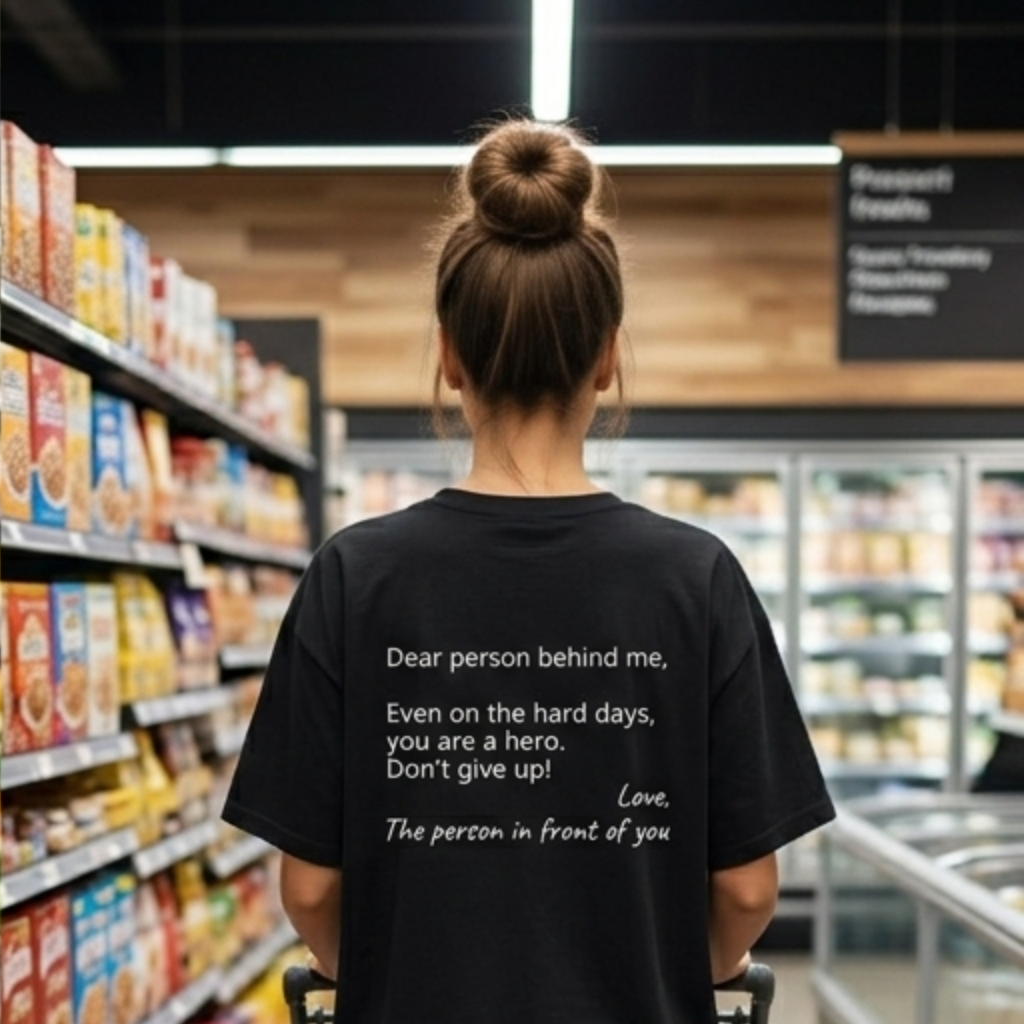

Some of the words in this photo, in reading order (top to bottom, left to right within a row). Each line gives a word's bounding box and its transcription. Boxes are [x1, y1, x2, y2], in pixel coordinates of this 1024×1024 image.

[387, 647, 443, 668] Dear
[449, 651, 531, 673] person
[538, 646, 618, 668] behind
[626, 651, 668, 670] me,
[387, 703, 442, 724] Even
[449, 708, 479, 724] on
[487, 703, 525, 724] the
[533, 702, 587, 724] hard
[595, 702, 655, 729] days,
[386, 735, 430, 756] you
[437, 735, 476, 752] are
[483, 735, 497, 752] a
[505, 730, 565, 752] hero.
[387, 758, 451, 780] Don't
[457, 758, 507, 784] give
[514, 758, 551, 784] up!
[617, 783, 669, 808] Love,
[386, 817, 425, 842] The
[430, 825, 504, 846] person
[511, 821, 532, 840] in
[539, 817, 599, 844] front
[605, 817, 631, 844] of
[631, 825, 671, 848] you
